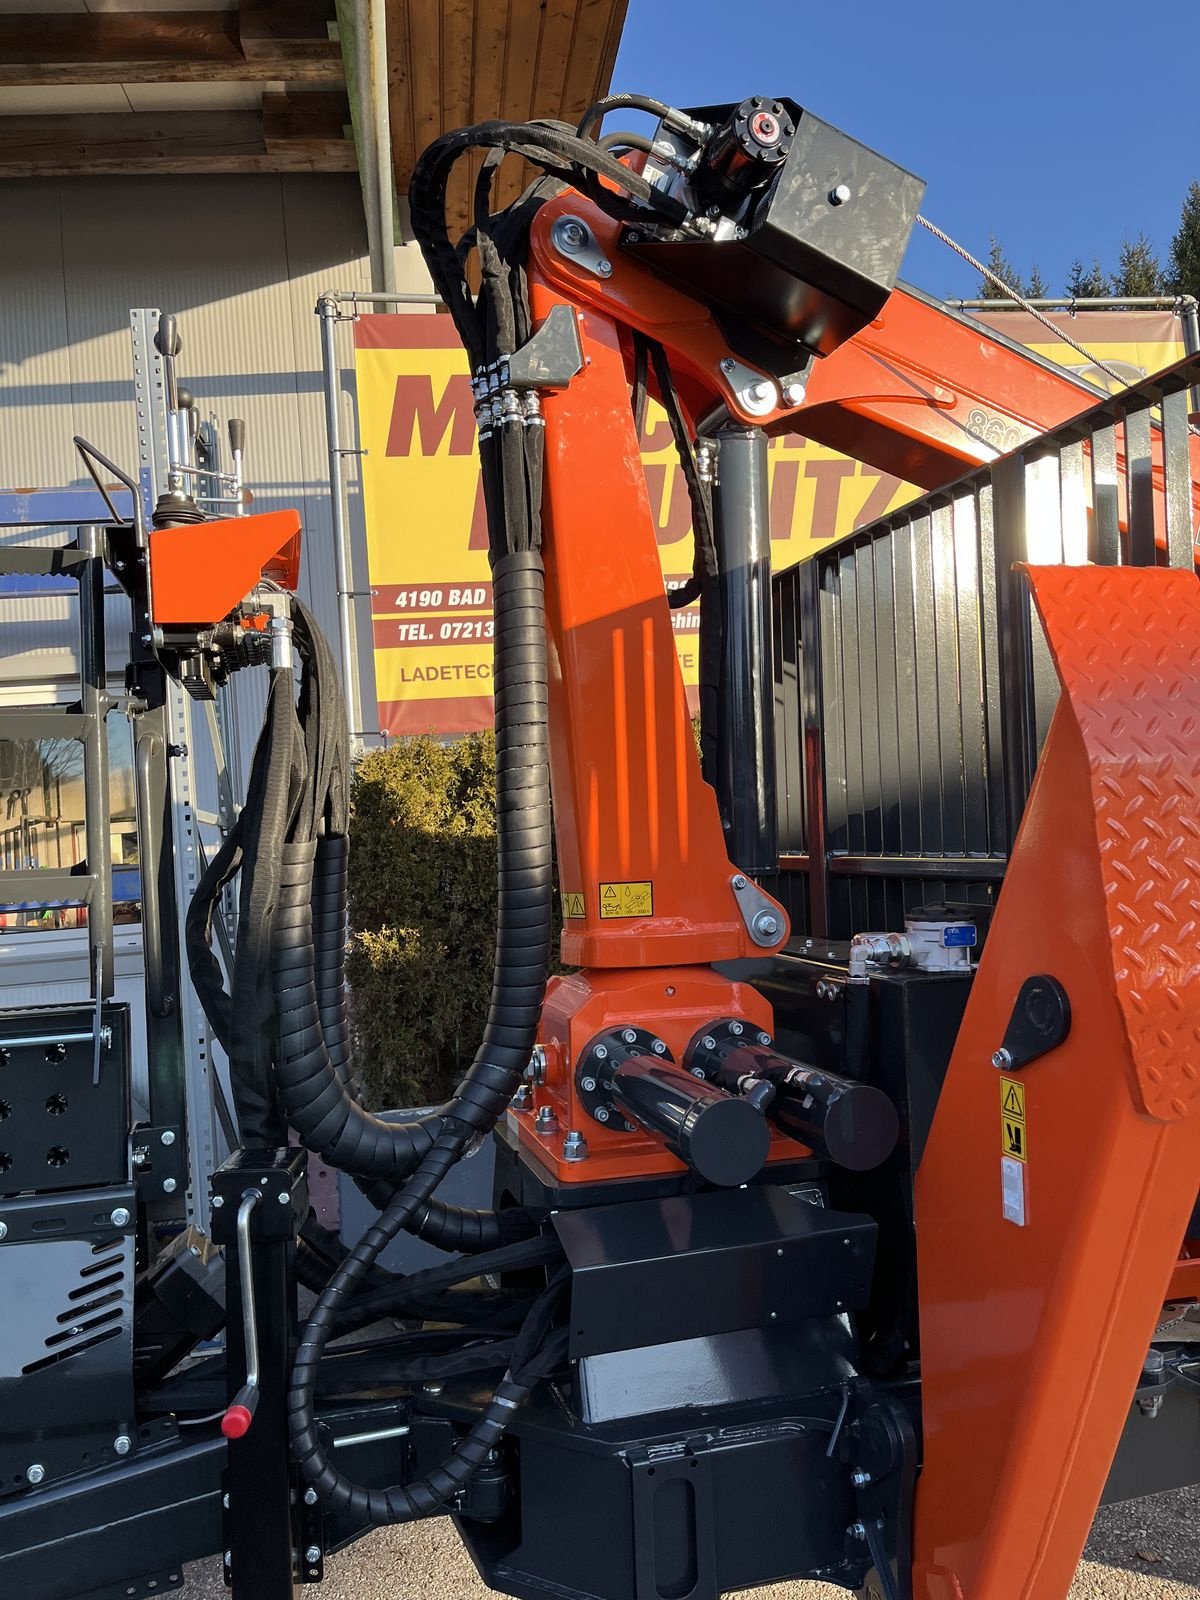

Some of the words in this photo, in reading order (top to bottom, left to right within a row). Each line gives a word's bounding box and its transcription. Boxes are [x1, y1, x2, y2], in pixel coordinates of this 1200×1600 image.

[395, 590, 443, 608] 4190
[448, 588, 486, 606] BAD
[398, 623, 434, 641] TEL.
[401, 663, 495, 683] LADETEC
